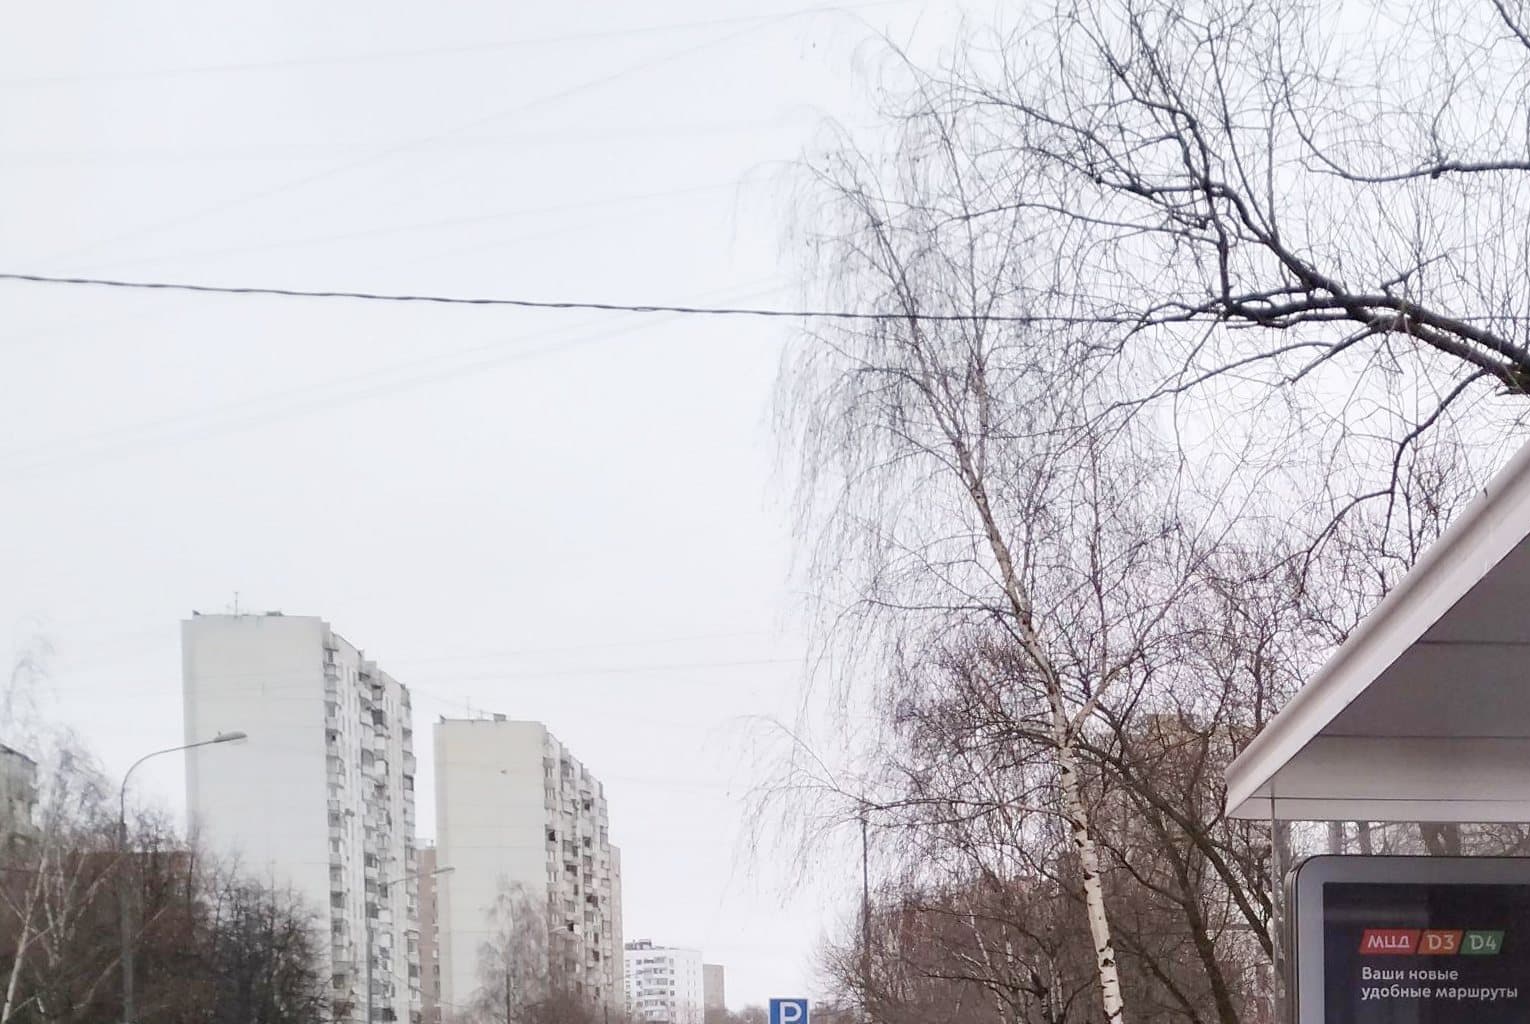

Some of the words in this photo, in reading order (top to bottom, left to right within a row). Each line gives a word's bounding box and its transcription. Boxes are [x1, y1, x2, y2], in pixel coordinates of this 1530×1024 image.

[1367, 935, 1410, 949] МЦД
[1426, 934, 1455, 950] D3
[1469, 934, 1497, 950] D4
[1361, 966, 1405, 980] Ваши
[1408, 969, 1459, 981] новые
[1361, 984, 1432, 1001] удобные
[1435, 986, 1519, 1001] маршруты
